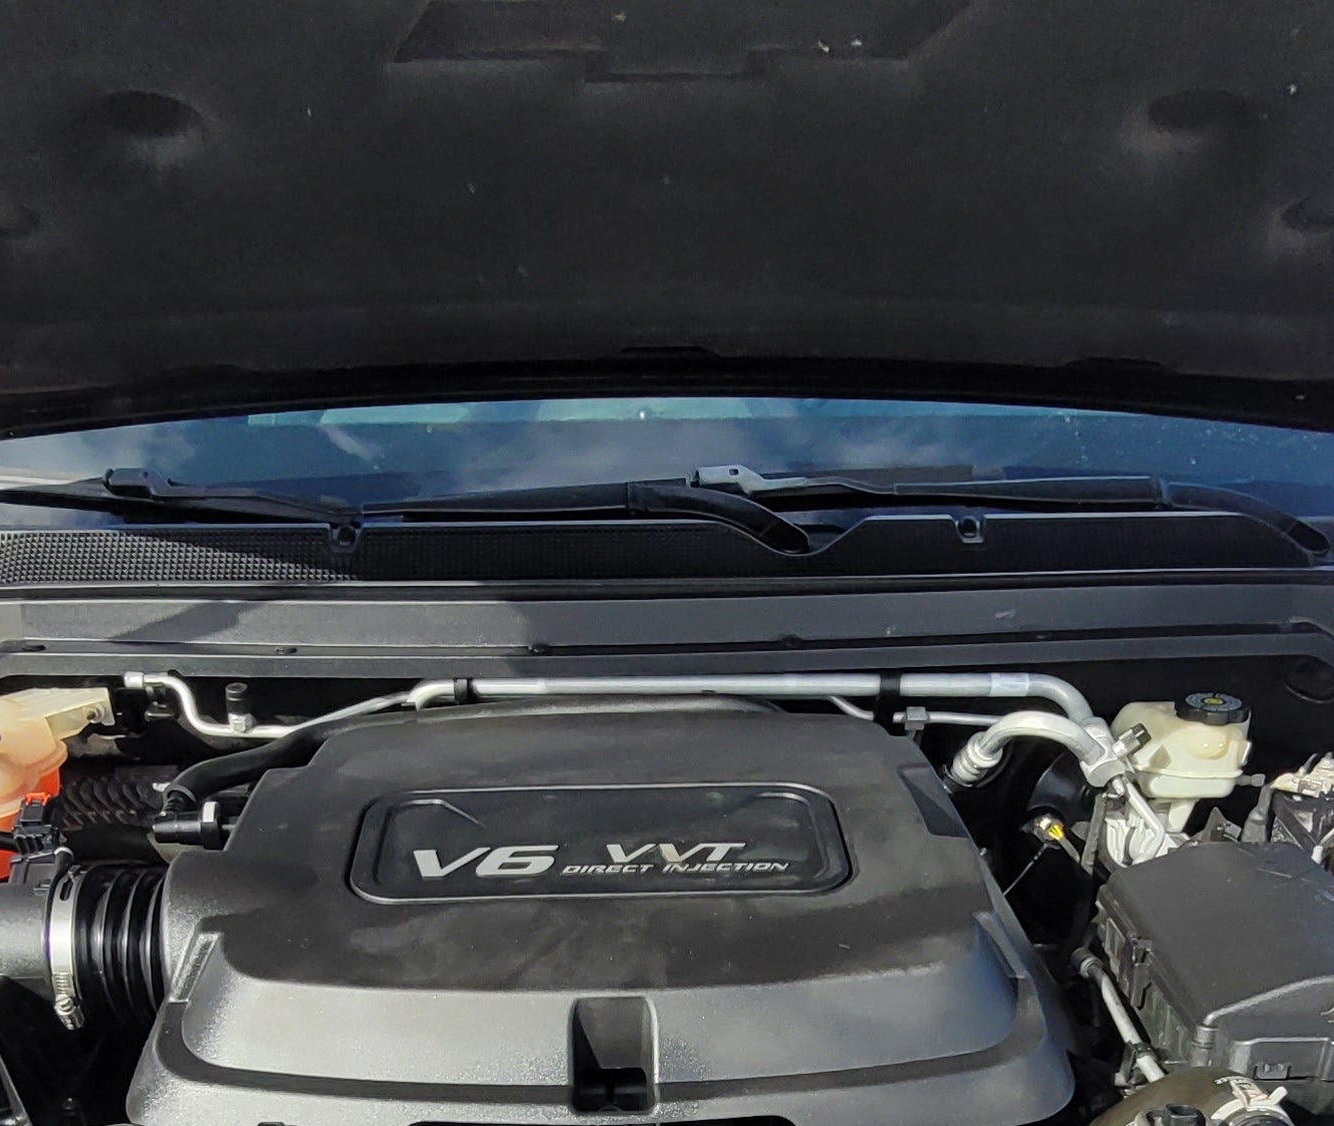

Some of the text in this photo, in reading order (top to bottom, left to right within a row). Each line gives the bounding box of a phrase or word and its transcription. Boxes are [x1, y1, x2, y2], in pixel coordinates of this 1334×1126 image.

[413, 845, 559, 878] V6
[605, 843, 746, 863] VVT
[561, 862, 789, 875] DIRECT INJECTION
